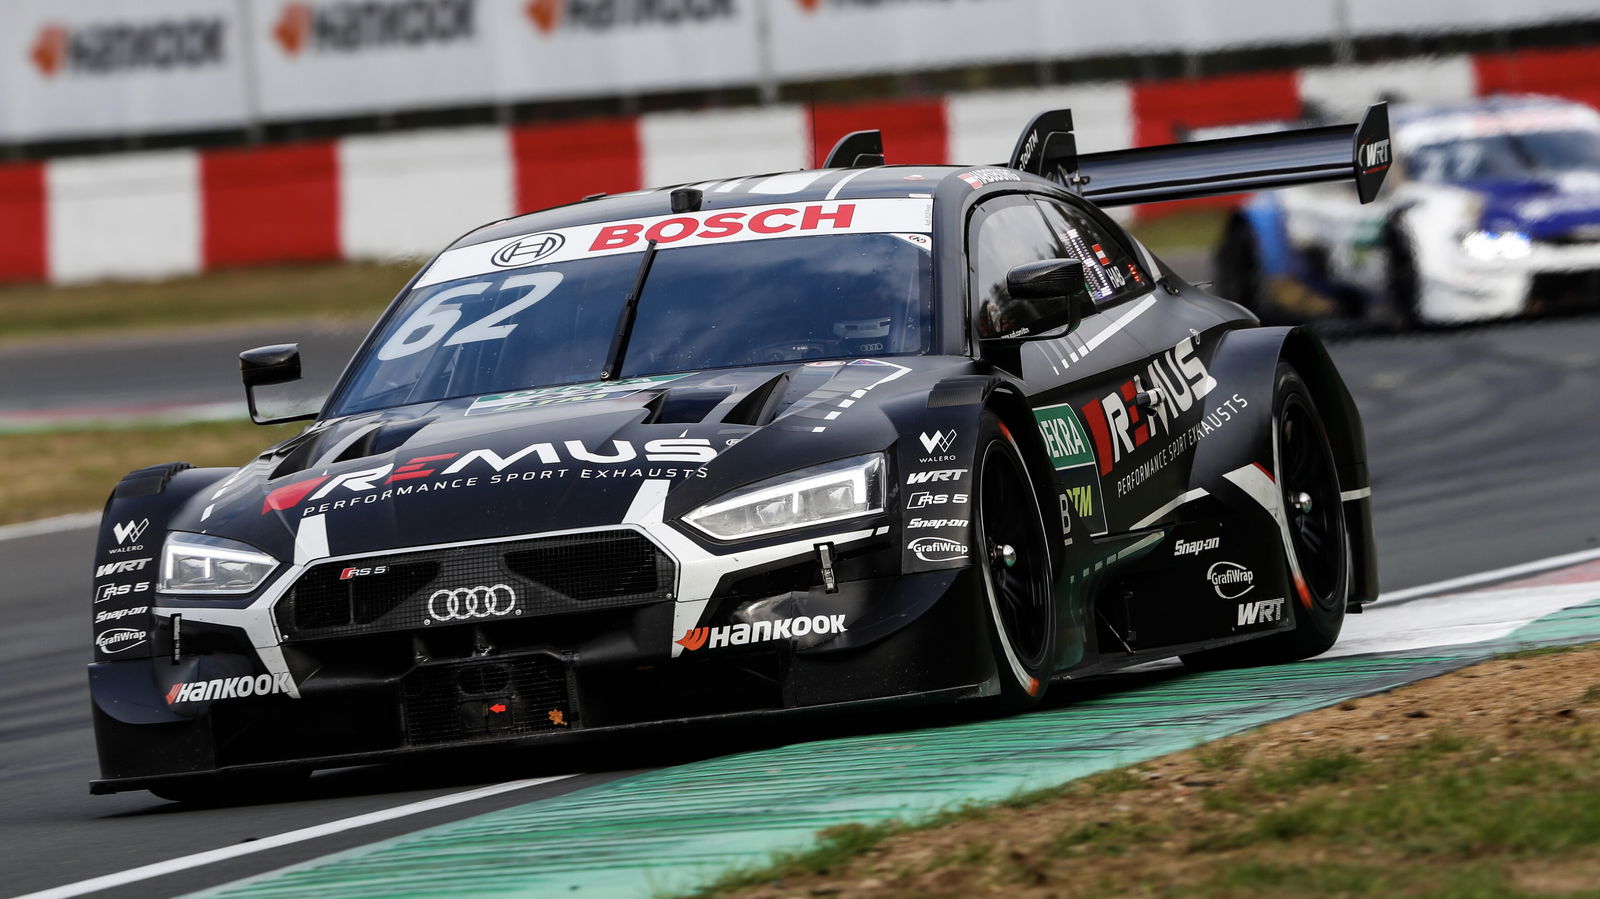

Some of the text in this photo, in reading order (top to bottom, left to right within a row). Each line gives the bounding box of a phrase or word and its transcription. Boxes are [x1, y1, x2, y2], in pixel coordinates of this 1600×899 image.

[1366, 138, 1390, 168] WRT
[588, 204, 856, 251] BOSCH
[1105, 265, 1126, 289] HAB
[377, 271, 564, 361] 62
[1101, 335, 1218, 464] REMUS
[1117, 449, 1168, 498] PERFORMANCE
[1188, 393, 1248, 446] EXHAUSTS
[919, 454, 956, 464] WALERO
[307, 438, 718, 502] REMUS
[906, 469, 968, 485] WRT
[303, 467, 709, 517] PERFORMANCE SPORT EXHAUSTS
[917, 494, 969, 506] RS 5
[906, 518, 969, 529] Snap-on
[108, 545, 144, 555] WALERO
[912, 541, 968, 555] GrafiWrap
[1173, 536, 1220, 556] Snap-on
[95, 557, 153, 578] WRT
[346, 565, 387, 578] RS 5
[1211, 568, 1254, 585] GrafiWrap
[102, 581, 150, 599] RS 5
[94, 606, 148, 624] Snap-on
[1237, 597, 1285, 626] WRT
[98, 630, 147, 647] GrafiWrap
